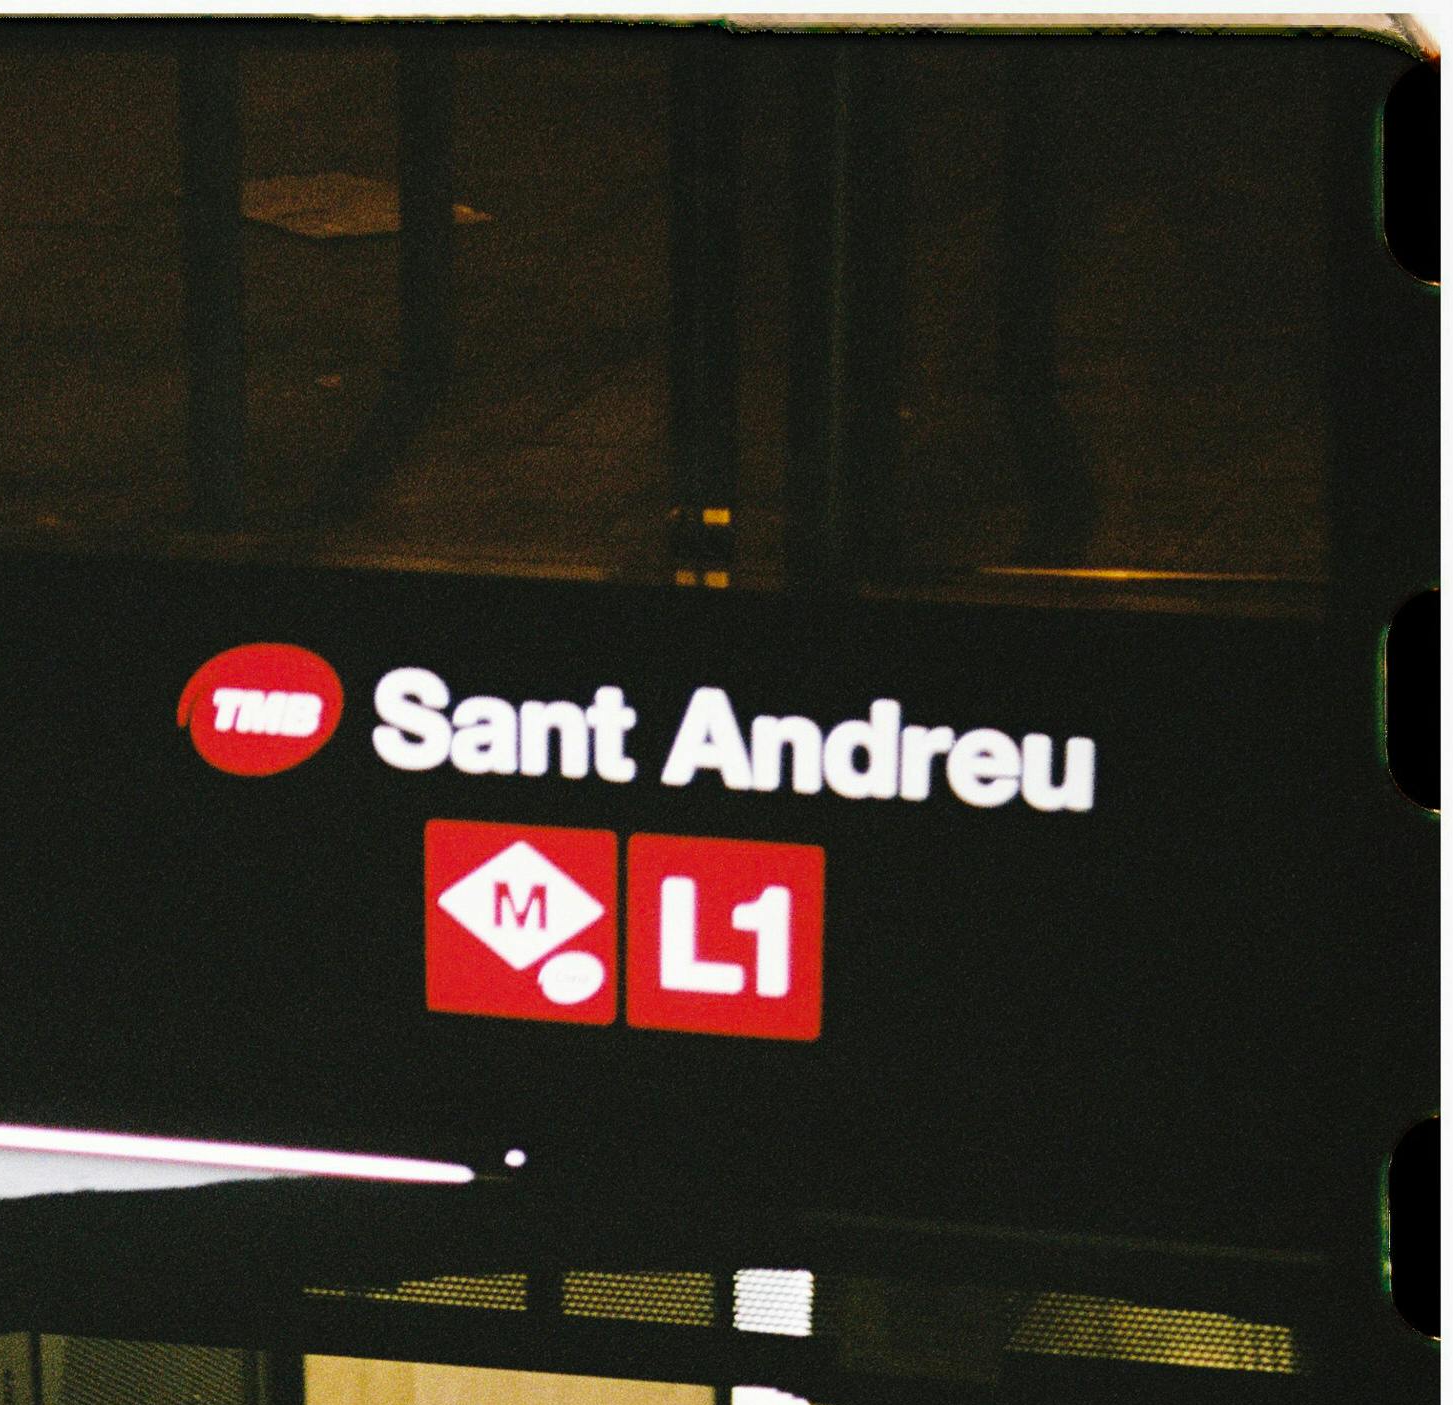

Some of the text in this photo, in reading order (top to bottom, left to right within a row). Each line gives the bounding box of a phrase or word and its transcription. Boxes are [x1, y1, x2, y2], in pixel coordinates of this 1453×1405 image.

[212, 688, 323, 738] TMB
[372, 667, 1095, 811] Sant Andreu
[493, 876, 791, 998] M L1
